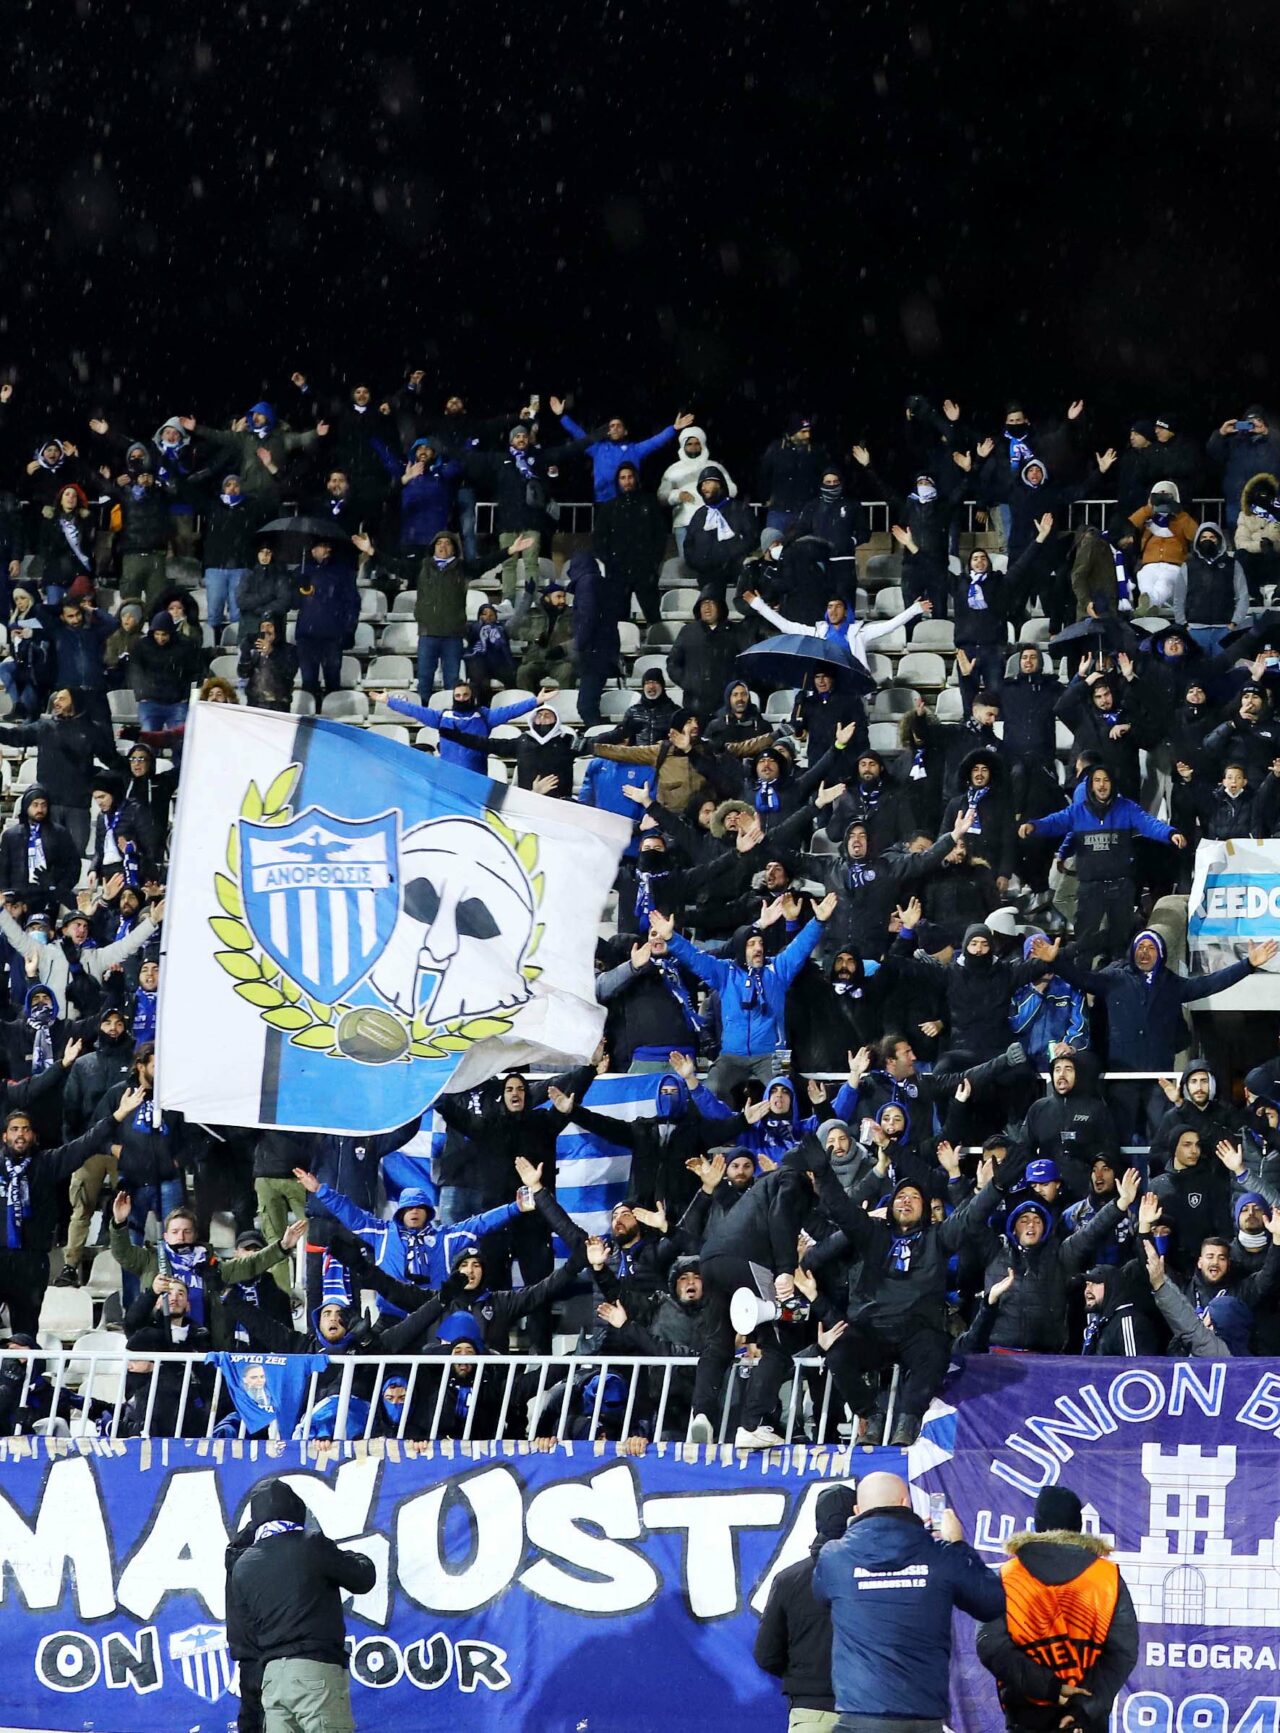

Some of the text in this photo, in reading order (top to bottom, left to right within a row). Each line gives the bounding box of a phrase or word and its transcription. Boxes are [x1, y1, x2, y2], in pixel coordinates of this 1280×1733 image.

[990, 1362, 1227, 1499] UNION
[36, 1627, 511, 1693] ON OUR
